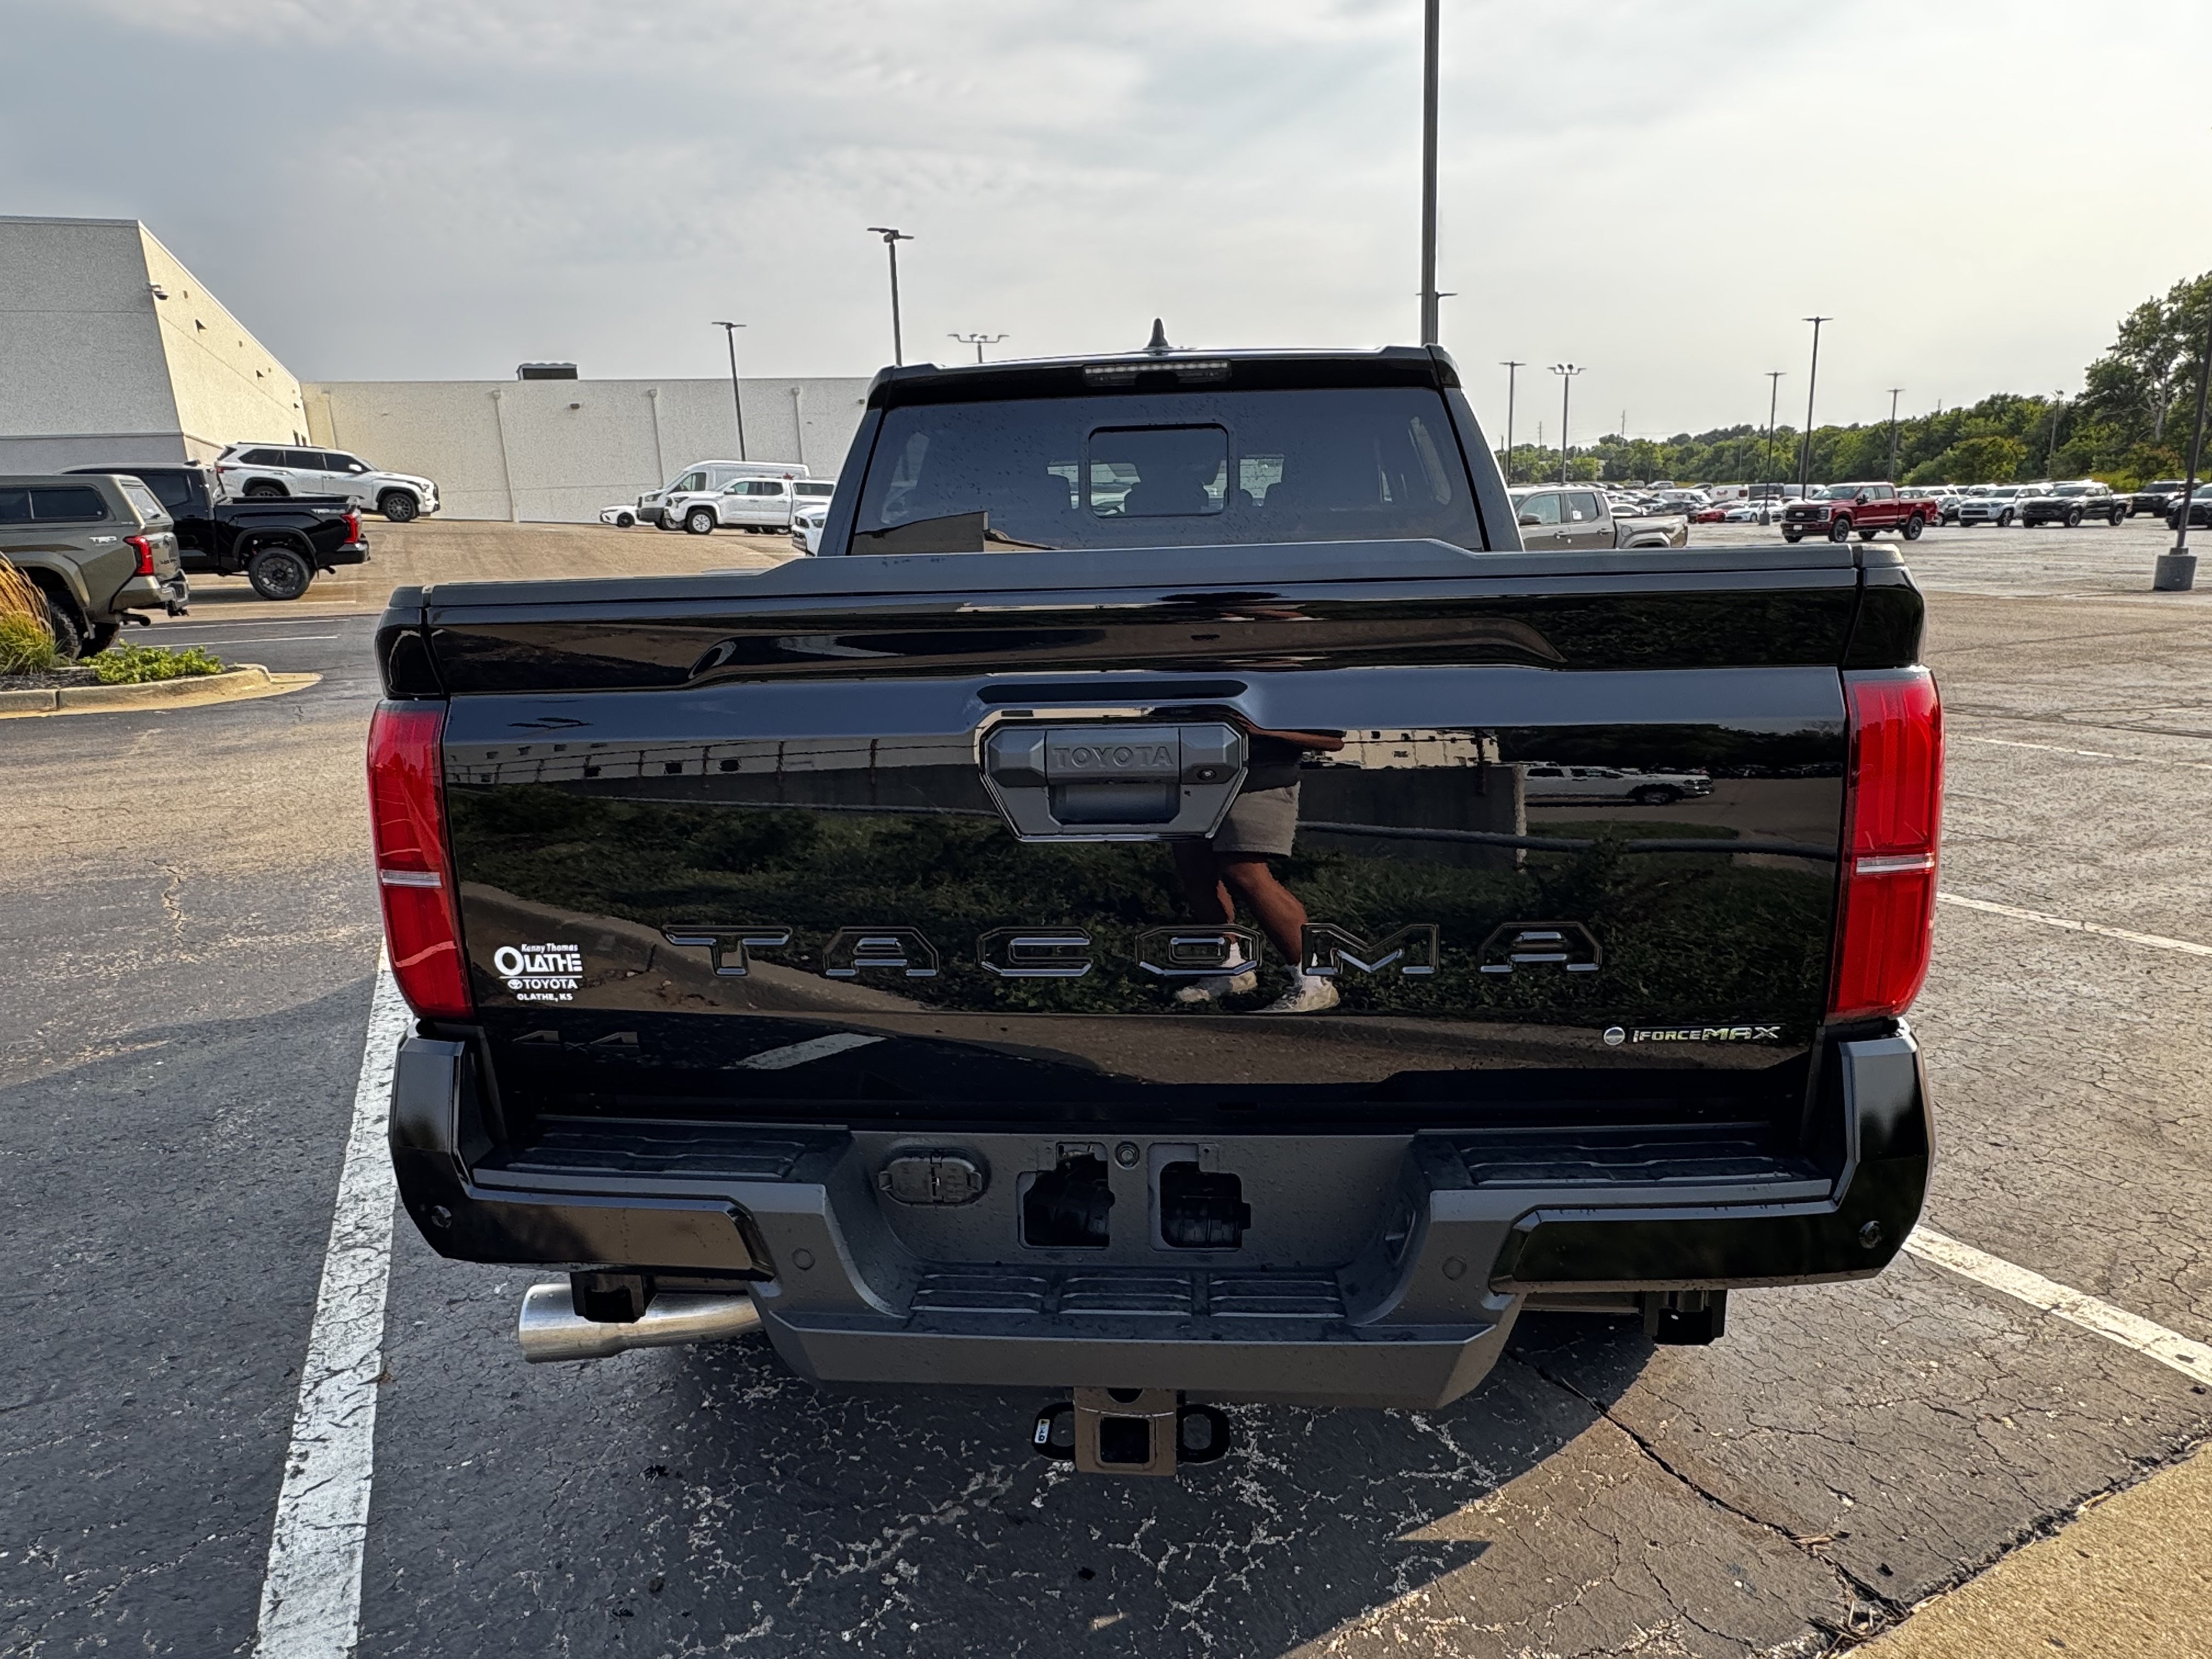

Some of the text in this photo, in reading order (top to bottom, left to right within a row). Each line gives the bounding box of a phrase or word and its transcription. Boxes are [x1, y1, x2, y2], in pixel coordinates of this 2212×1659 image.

[89, 535, 117, 544] TRD
[1052, 745, 1174, 769] TOYOTA
[521, 943, 578, 953] Kenny Thomas
[662, 921, 1603, 977] TACOMA
[494, 946, 583, 976] OLATHE
[522, 979, 578, 990] TOYOTA
[517, 993, 558, 1003] OLATHE,
